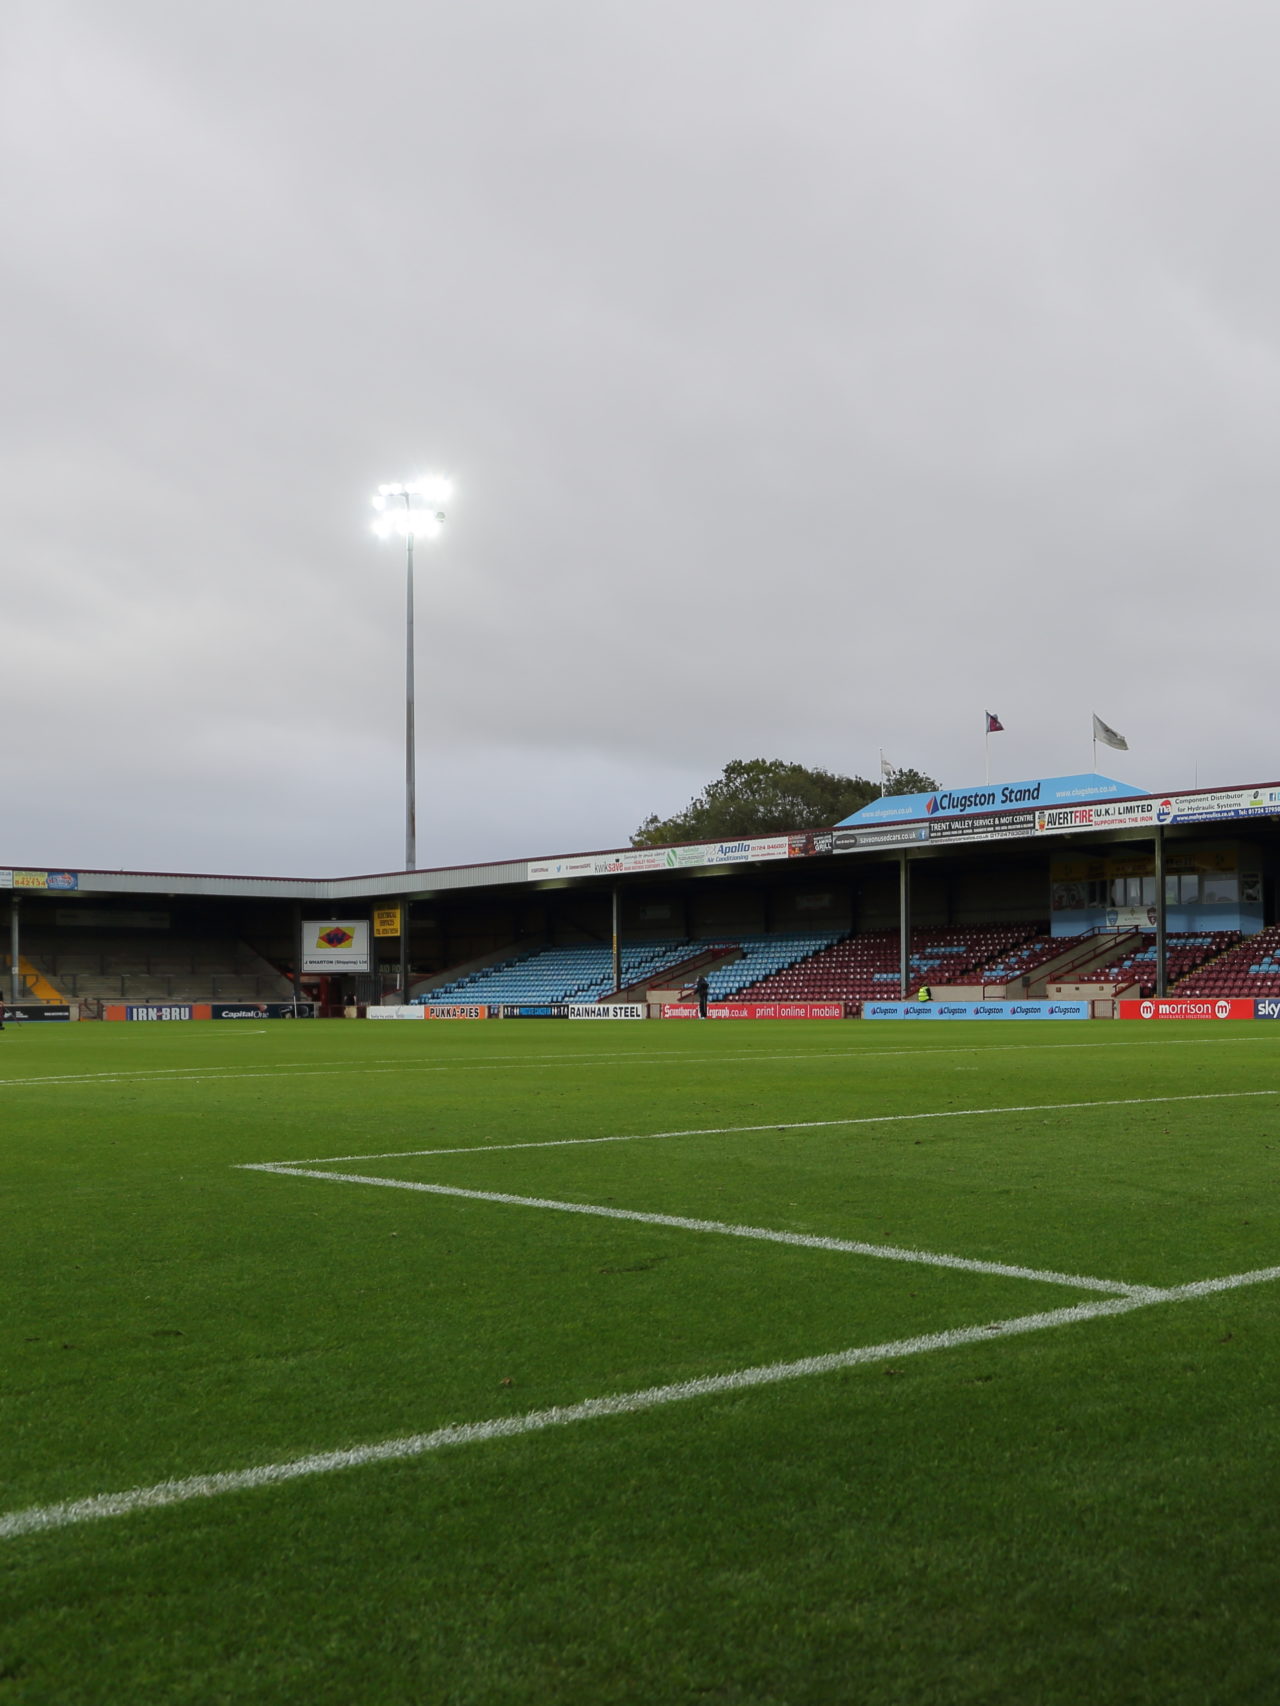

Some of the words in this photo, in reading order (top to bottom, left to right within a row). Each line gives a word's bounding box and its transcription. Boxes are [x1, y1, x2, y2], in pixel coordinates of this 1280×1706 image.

[940, 792, 996, 812] Clugston
[1000, 782, 1041, 804] Stand
[1175, 796, 1209, 805] Component
[1210, 793, 1244, 801] Distributor
[1118, 804, 1153, 815] LIMITED
[1187, 804, 1215, 813] Hydraulic
[930, 822, 950, 831] TRENT
[951, 820, 973, 830] VALLEY
[973, 818, 994, 827] SERVICE
[1000, 816, 1012, 824] MOT
[1013, 814, 1034, 823] CENTRE
[1094, 818, 1127, 826] SUPPORTING
[717, 842, 750, 855] Apollo
[715, 854, 749, 863] Conditioning
[430, 1007, 480, 1018] PUKKA-PIES
[569, 1006, 610, 1018] RAINHAM
[612, 1006, 641, 1018] STEEL
[755, 1006, 774, 1018] print
[780, 1005, 805, 1016] online
[812, 1005, 840, 1016] mobile
[1016, 1007, 1041, 1015] Clugston
[1054, 1007, 1080, 1015] Clugston
[1158, 1002, 1211, 1014] morrison
[1258, 1002, 1280, 1018] sky
